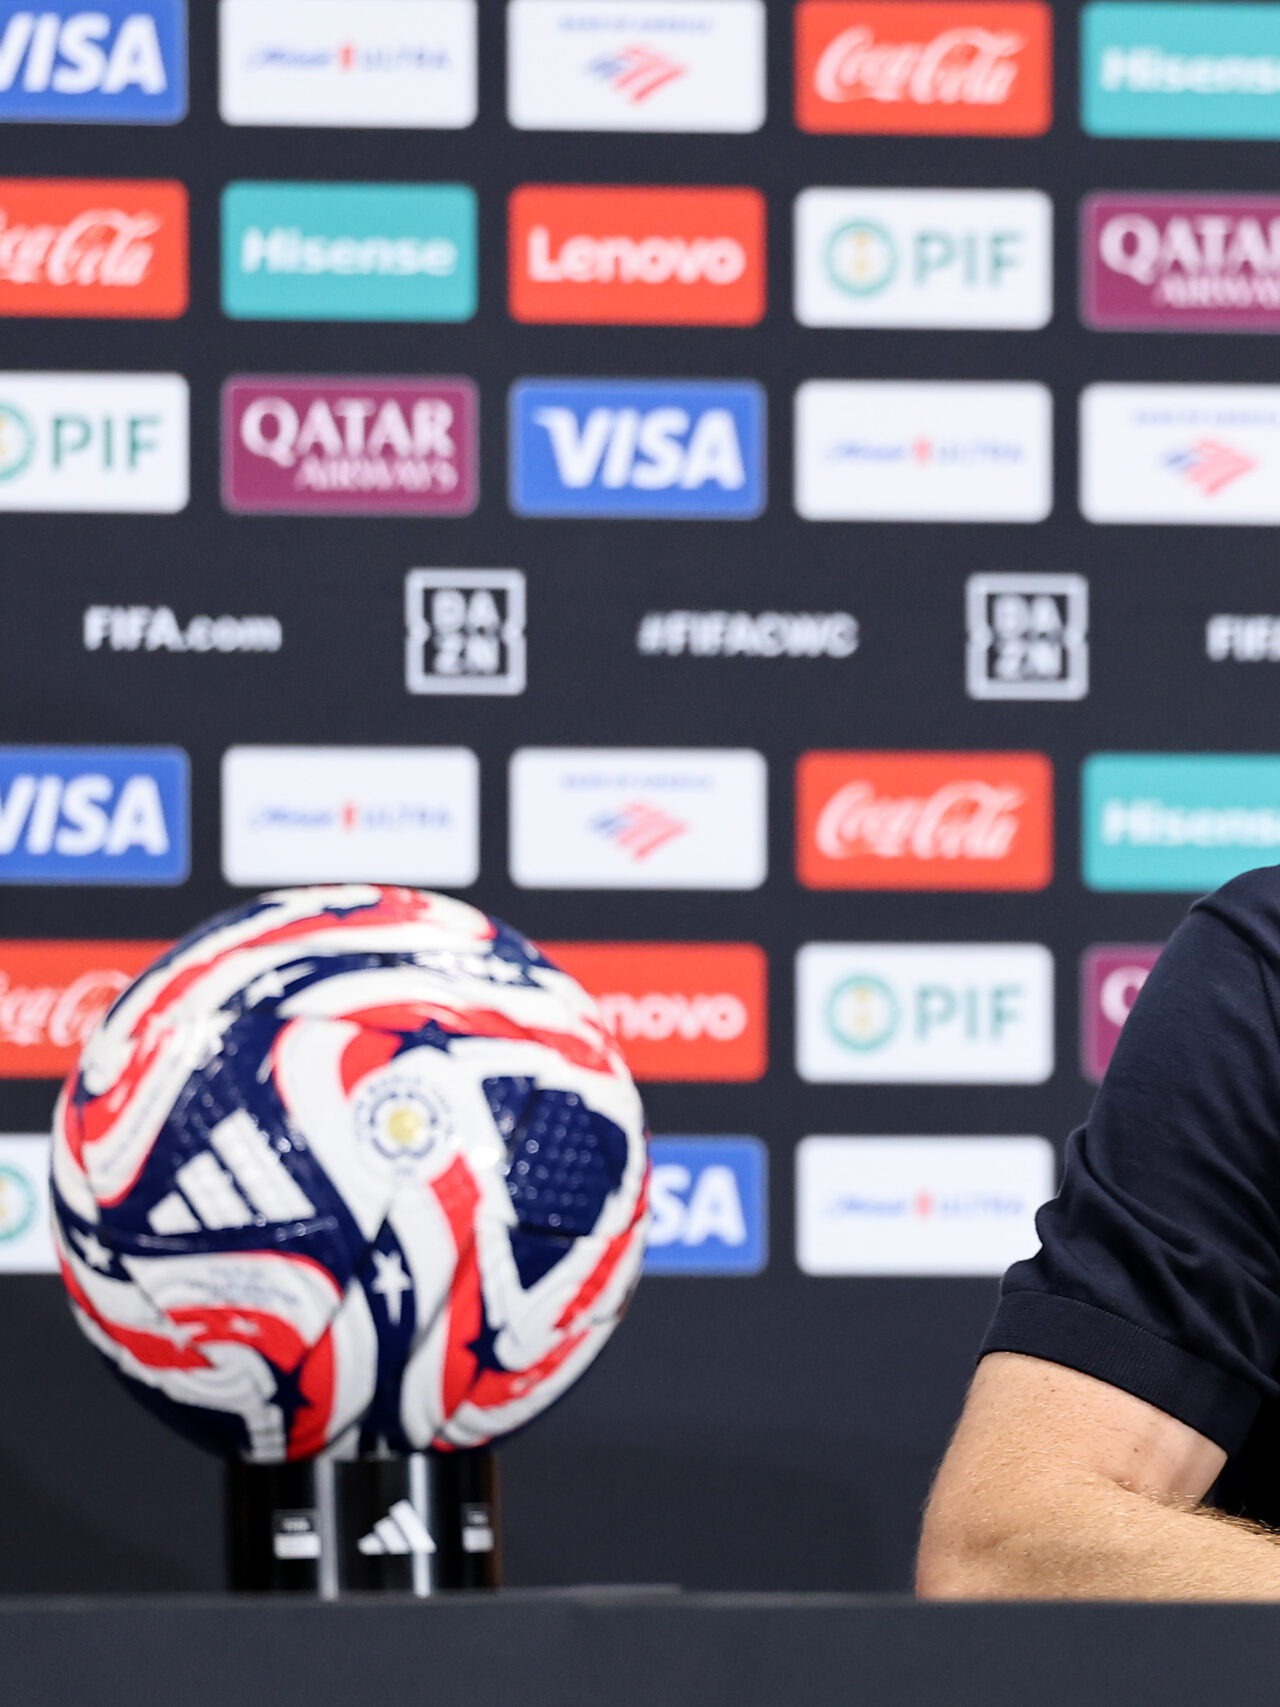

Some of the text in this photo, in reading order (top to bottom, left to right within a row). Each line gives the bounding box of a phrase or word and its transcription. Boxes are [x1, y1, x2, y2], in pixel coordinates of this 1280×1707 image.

[240, 226, 459, 277] Hisense
[526, 226, 747, 285] Lenovo
[911, 227, 1024, 288] PIF
[50, 413, 160, 471] PIF
[240, 397, 455, 467] QATAR
[532, 406, 746, 491] VISA
[83, 604, 284, 653] FIFA.com
[637, 609, 859, 659] #FIFACWC
[597, 993, 748, 1041] novo
[912, 982, 1023, 1042] PIF
[649, 1163, 748, 1247] SA
